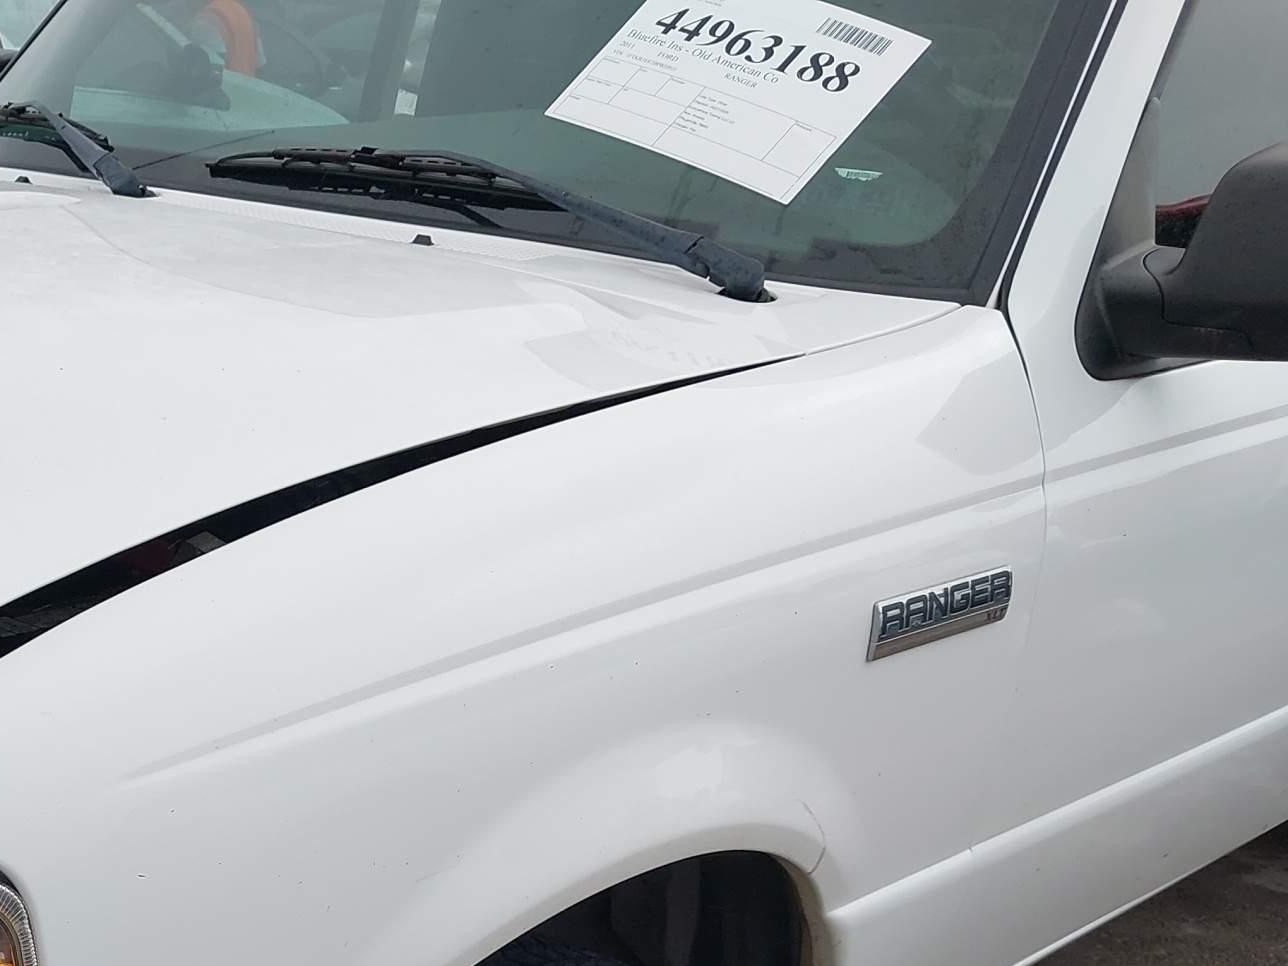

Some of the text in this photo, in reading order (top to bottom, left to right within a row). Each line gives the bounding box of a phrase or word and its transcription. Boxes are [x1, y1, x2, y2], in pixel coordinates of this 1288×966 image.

[626, 28, 667, 47] Bluefire
[666, 40, 684, 53] Ins
[691, 48, 713, 62] Old
[711, 54, 762, 78] American
[762, 71, 780, 84] Co
[655, 8, 861, 92] 44963188
[723, 72, 758, 89] RANGER
[880, 570, 1012, 636] RANGER
